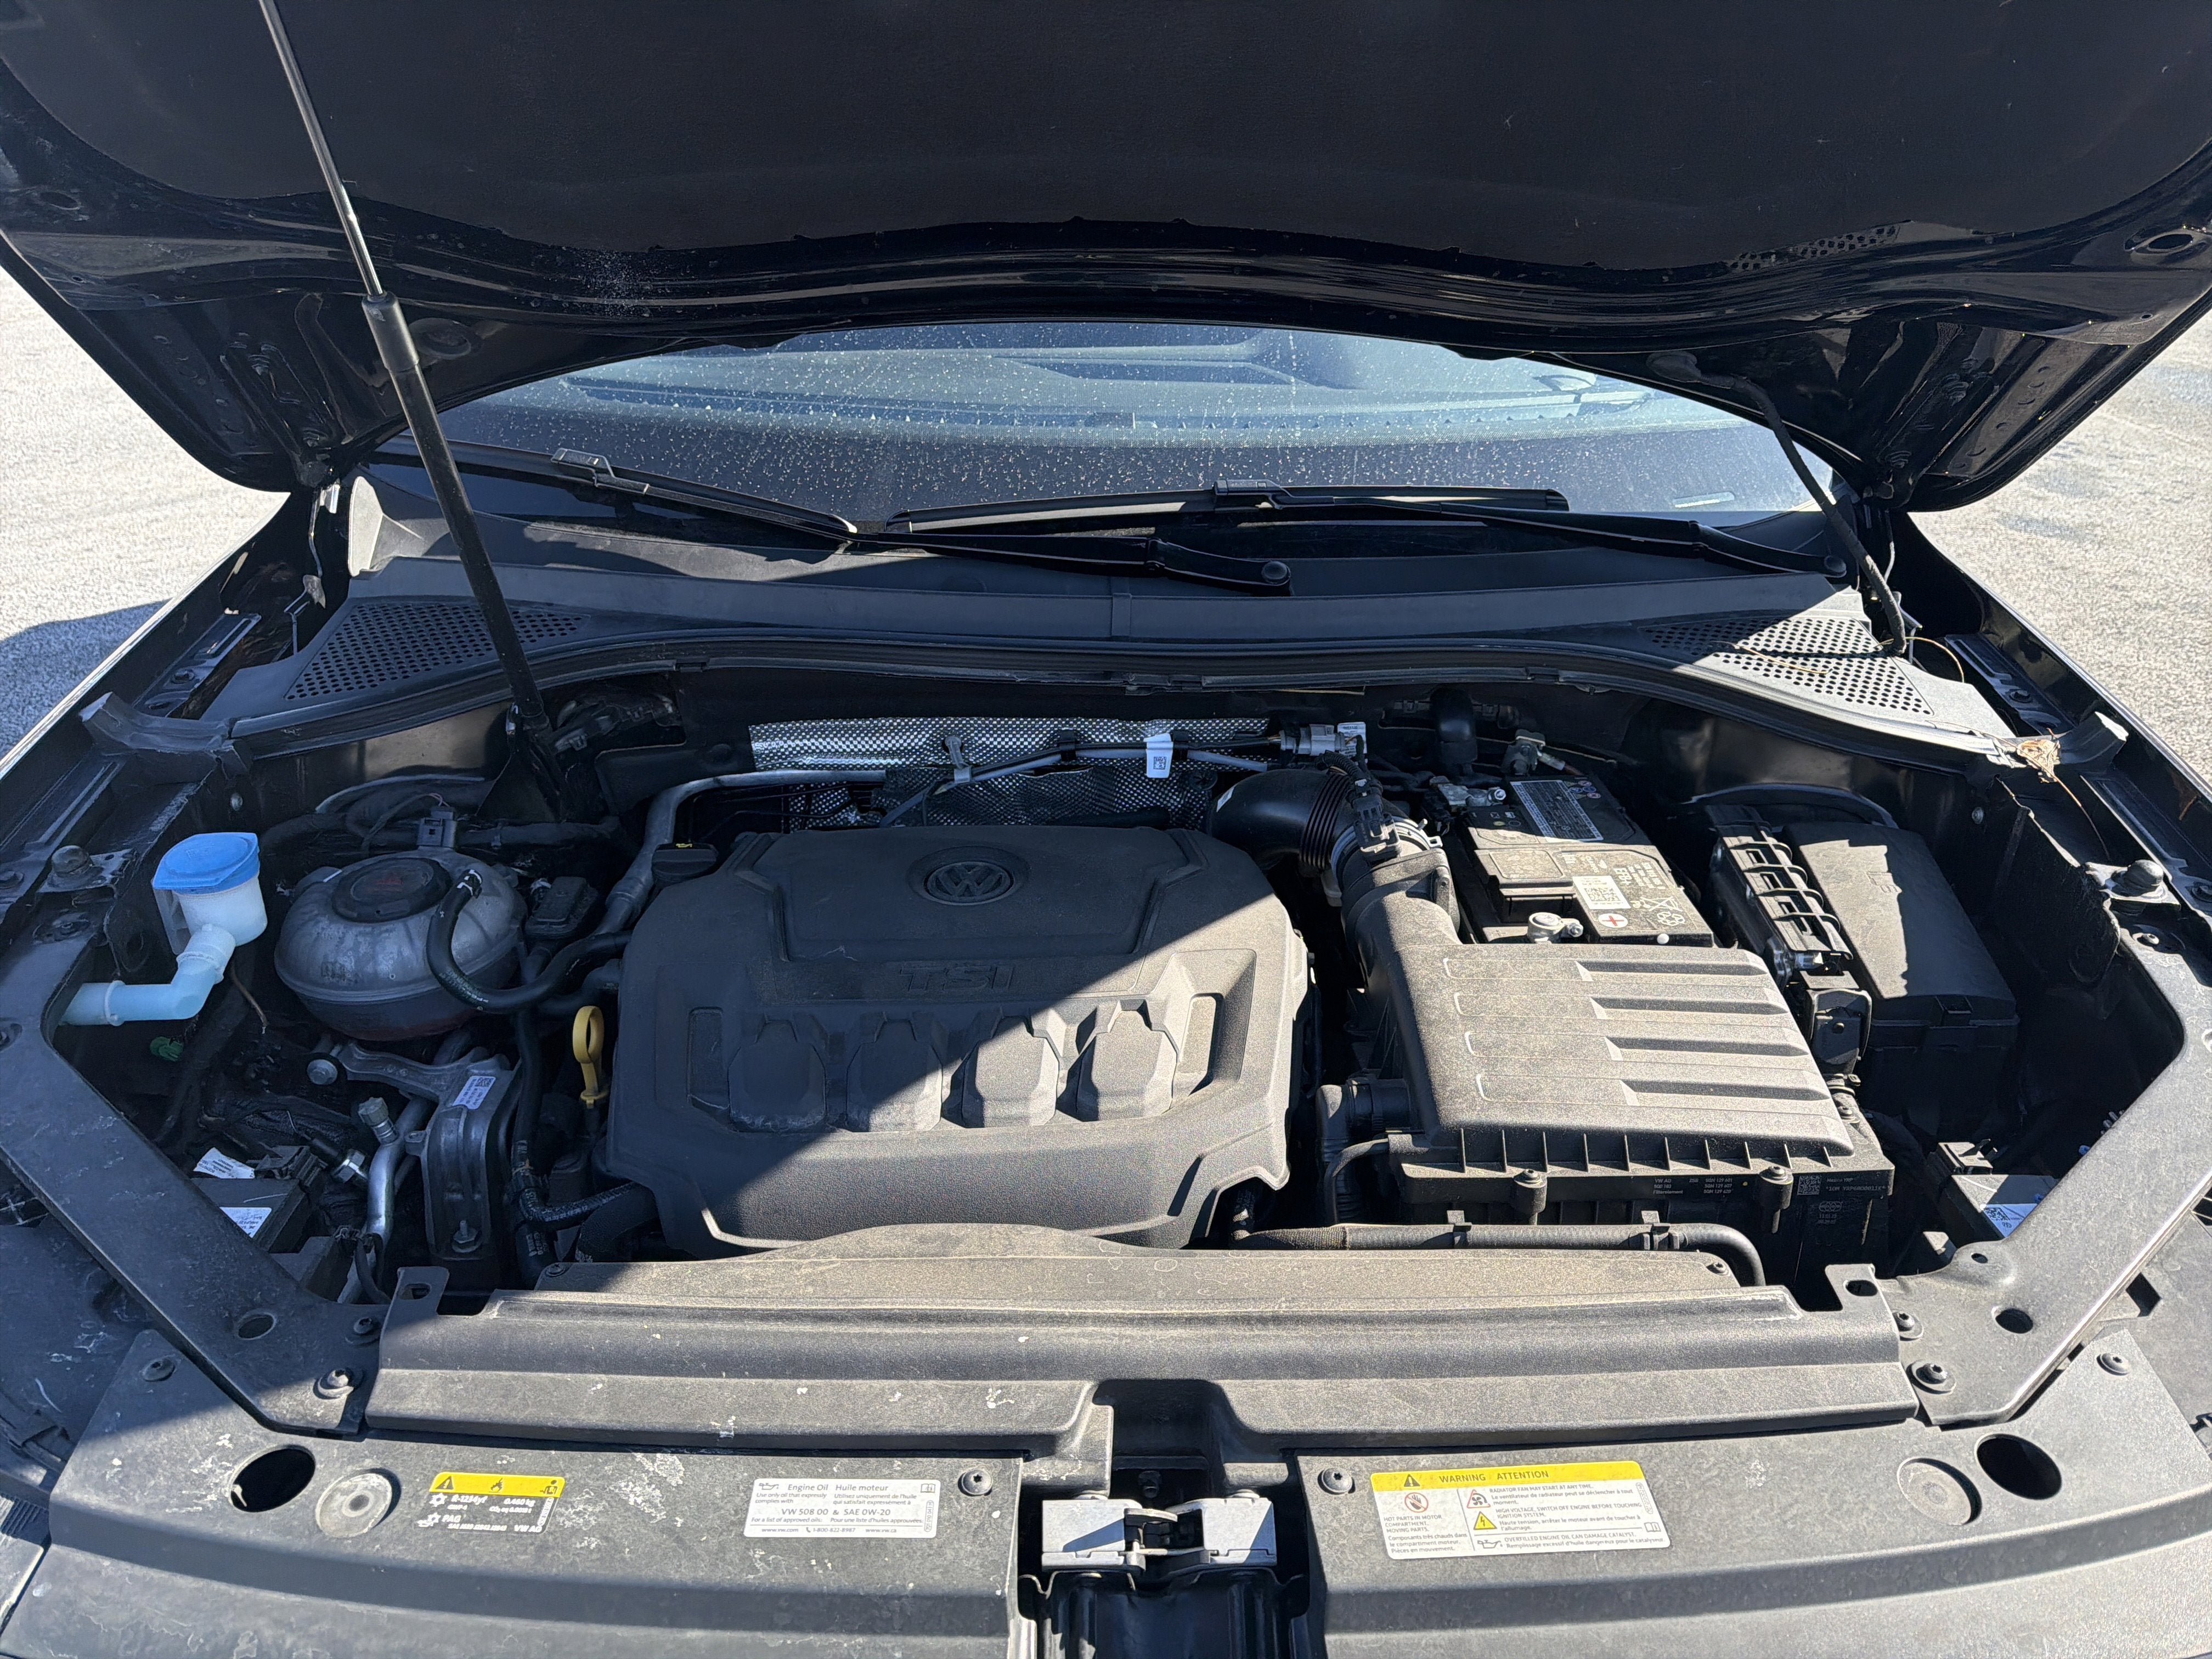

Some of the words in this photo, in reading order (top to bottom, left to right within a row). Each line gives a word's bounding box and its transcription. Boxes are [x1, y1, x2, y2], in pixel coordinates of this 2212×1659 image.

[900, 964, 1014, 991] TSI
[1439, 1474, 1486, 1483] WARNING
[1497, 1471, 1549, 1480] ATTENTION
[788, 1484, 815, 1492] Engine
[451, 1494, 488, 1505] R-1234yf
